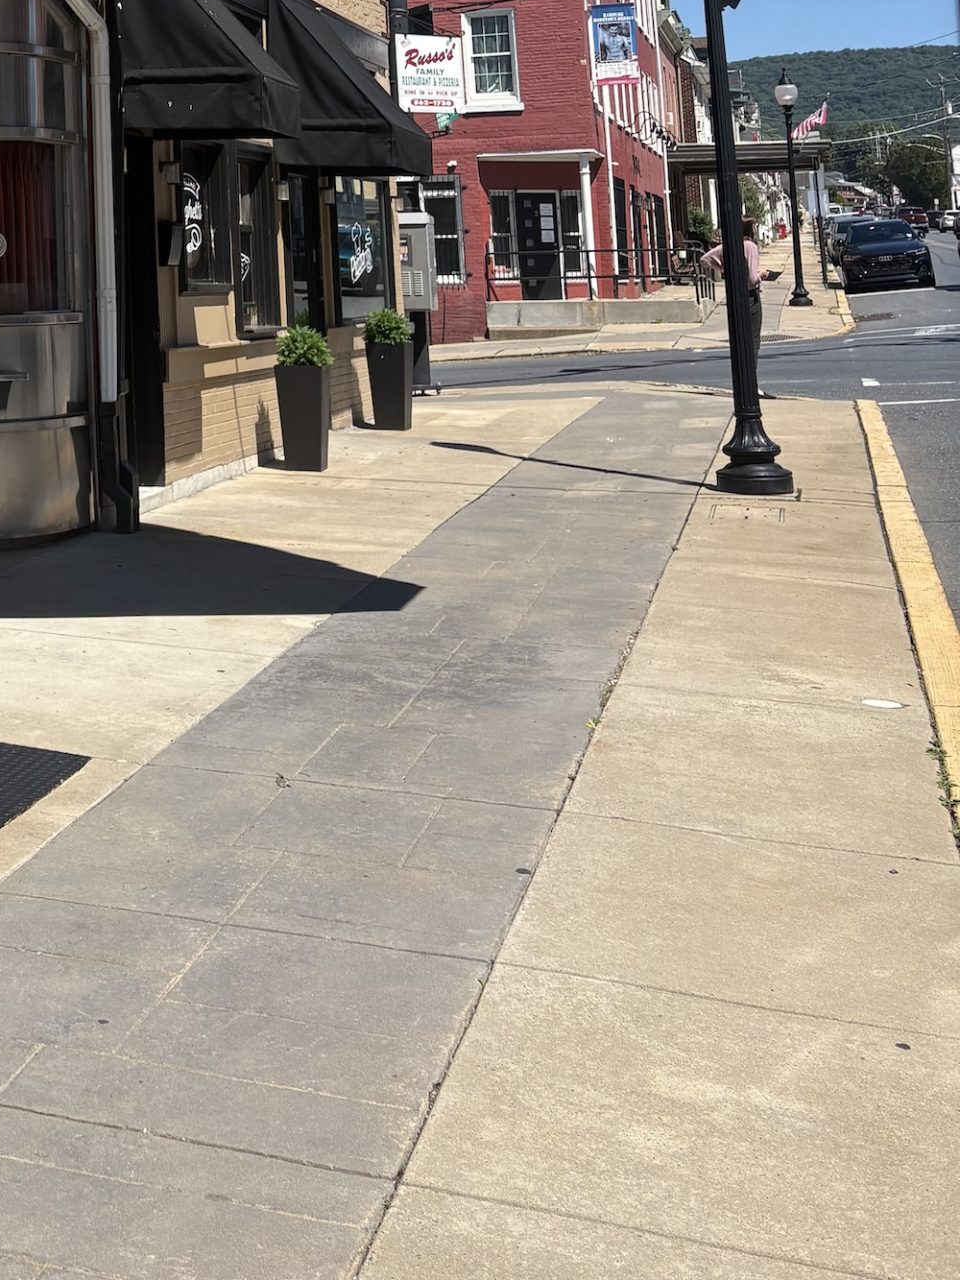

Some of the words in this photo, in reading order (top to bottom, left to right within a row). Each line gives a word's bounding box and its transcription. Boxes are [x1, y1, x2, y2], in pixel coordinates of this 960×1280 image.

[415, 68, 445, 76] FAMILY
[401, 76, 431, 86] RESTAURANT
[438, 77, 460, 87] PIZZERIA
